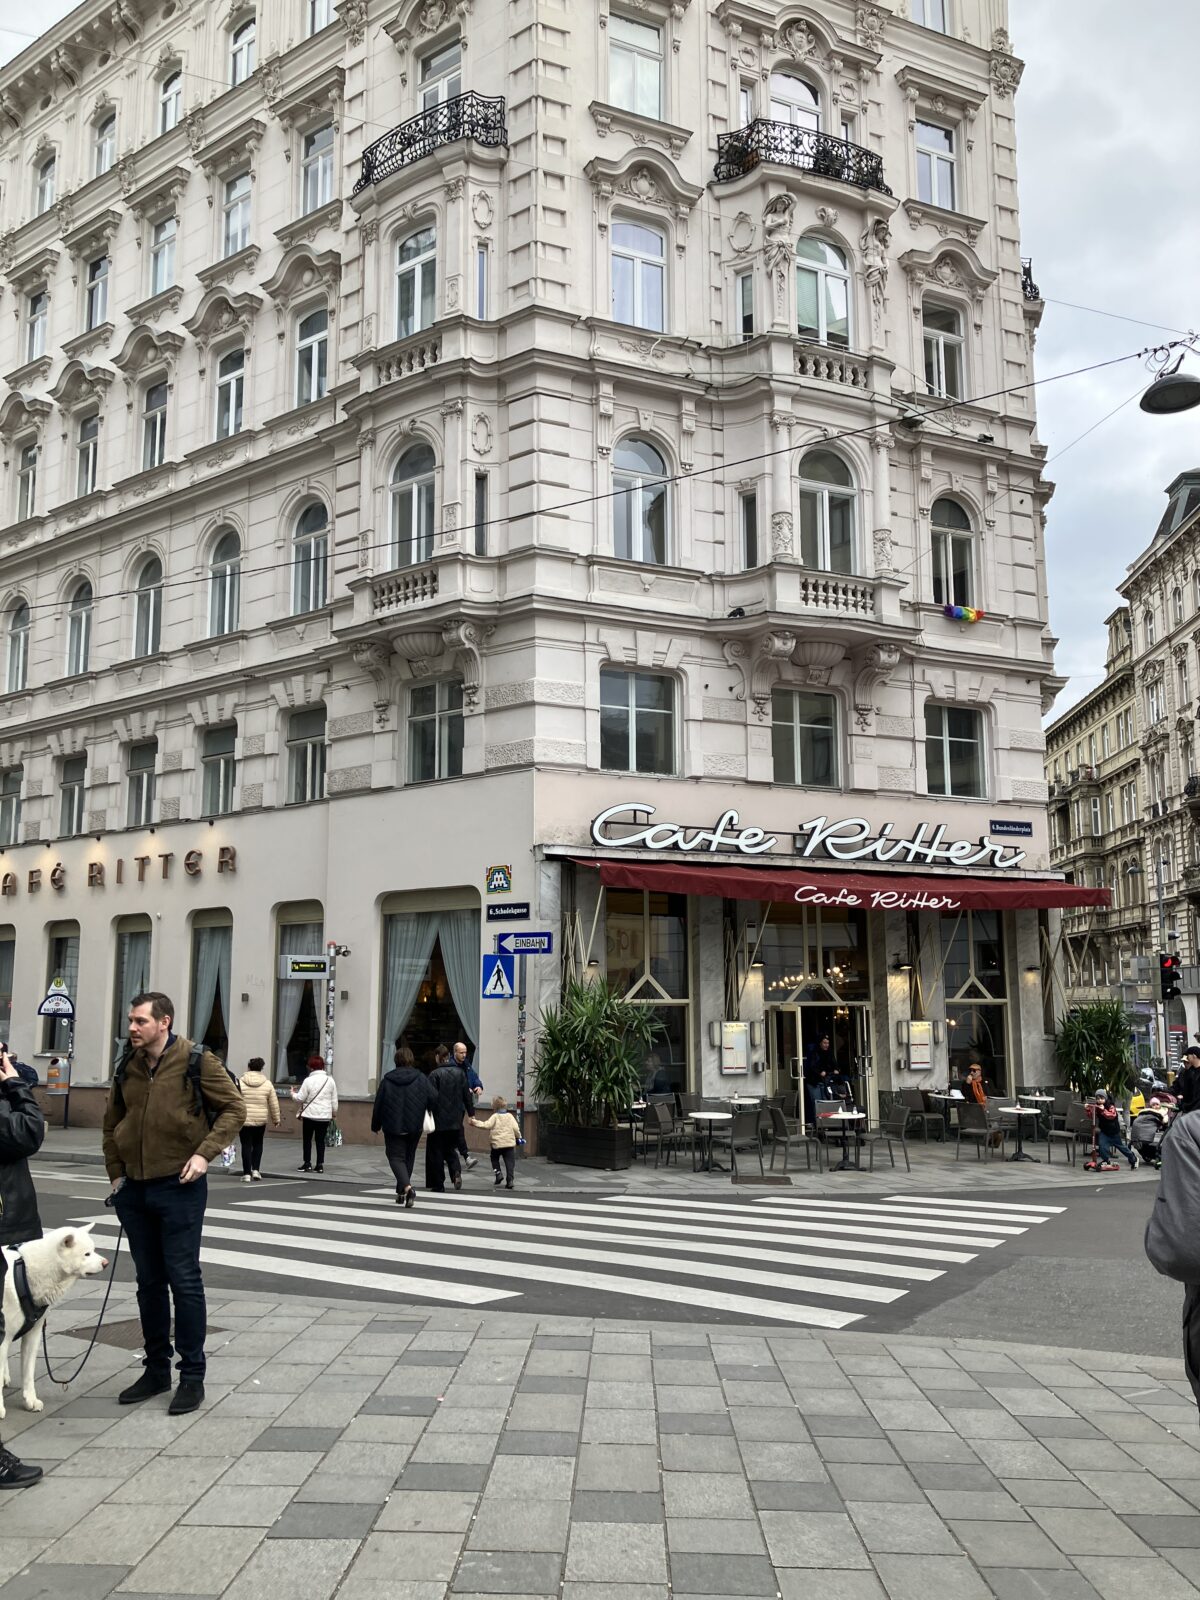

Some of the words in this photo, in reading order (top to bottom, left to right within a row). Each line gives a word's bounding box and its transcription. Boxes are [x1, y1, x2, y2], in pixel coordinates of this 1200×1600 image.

[591, 803, 778, 854] Cafe
[800, 816, 1027, 868] Ritter
[0, 862, 66, 896] AFÉ
[88, 846, 237, 887] RITTER
[794, 885, 863, 906] Cafe
[870, 891, 961, 909] Ritter
[515, 938, 546, 948] EINBAHN
